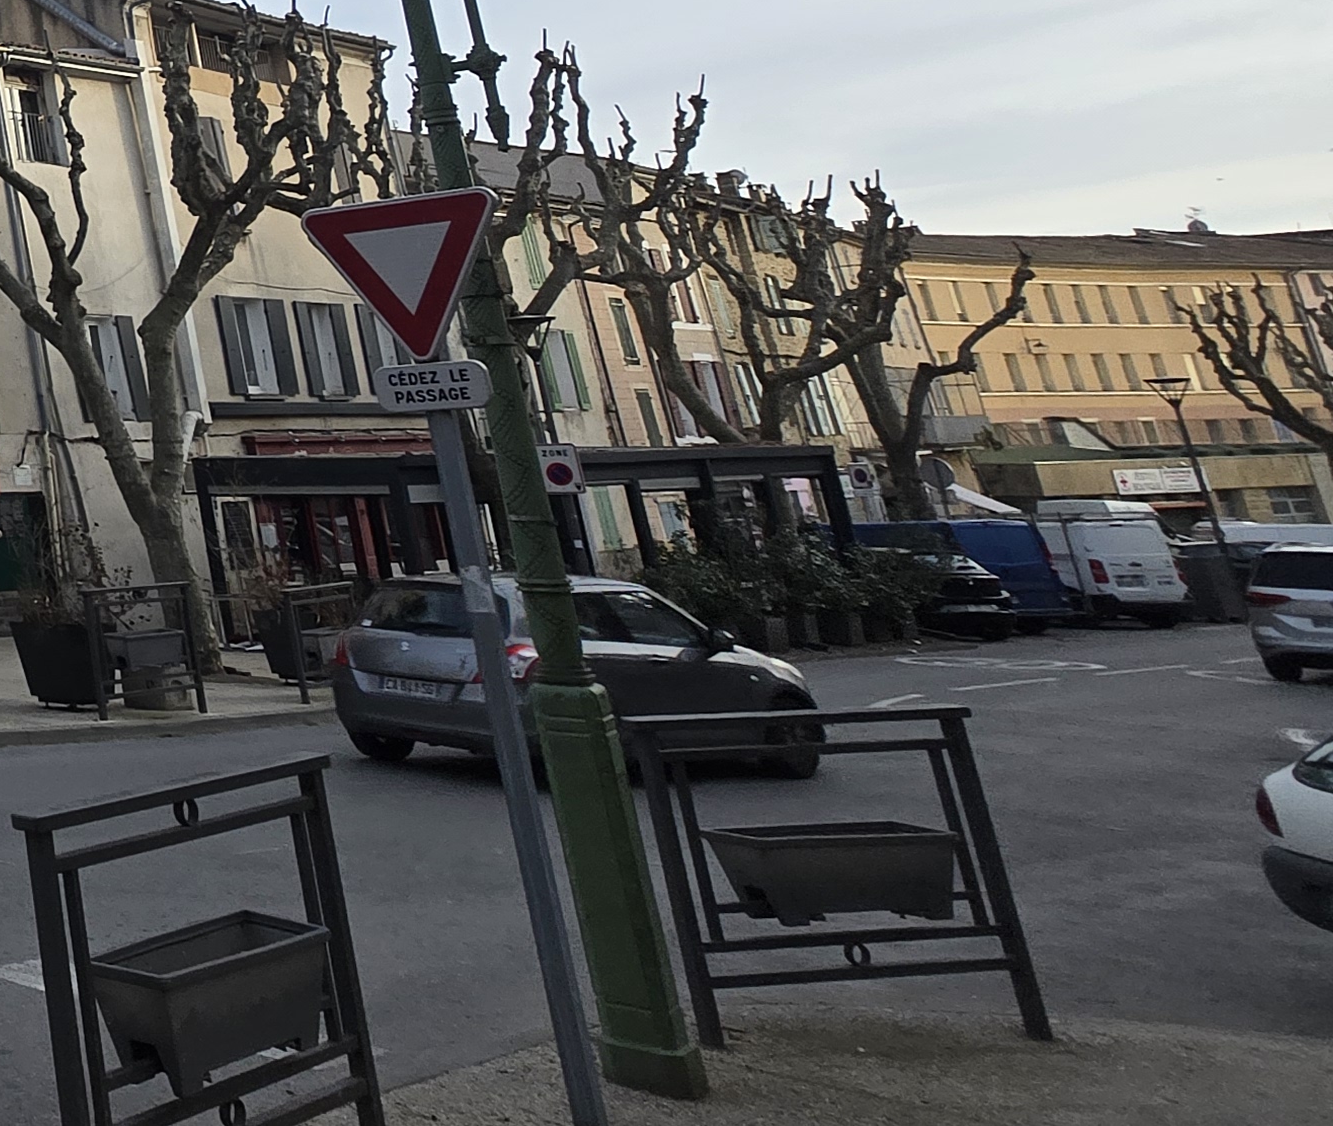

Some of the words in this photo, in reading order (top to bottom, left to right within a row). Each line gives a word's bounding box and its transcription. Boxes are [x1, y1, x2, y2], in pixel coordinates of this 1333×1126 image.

[388, 370, 440, 386] CÉDEZ
[448, 368, 471, 383] LE
[394, 386, 472, 404] PASSAGE
[541, 449, 569, 457] ZONE
